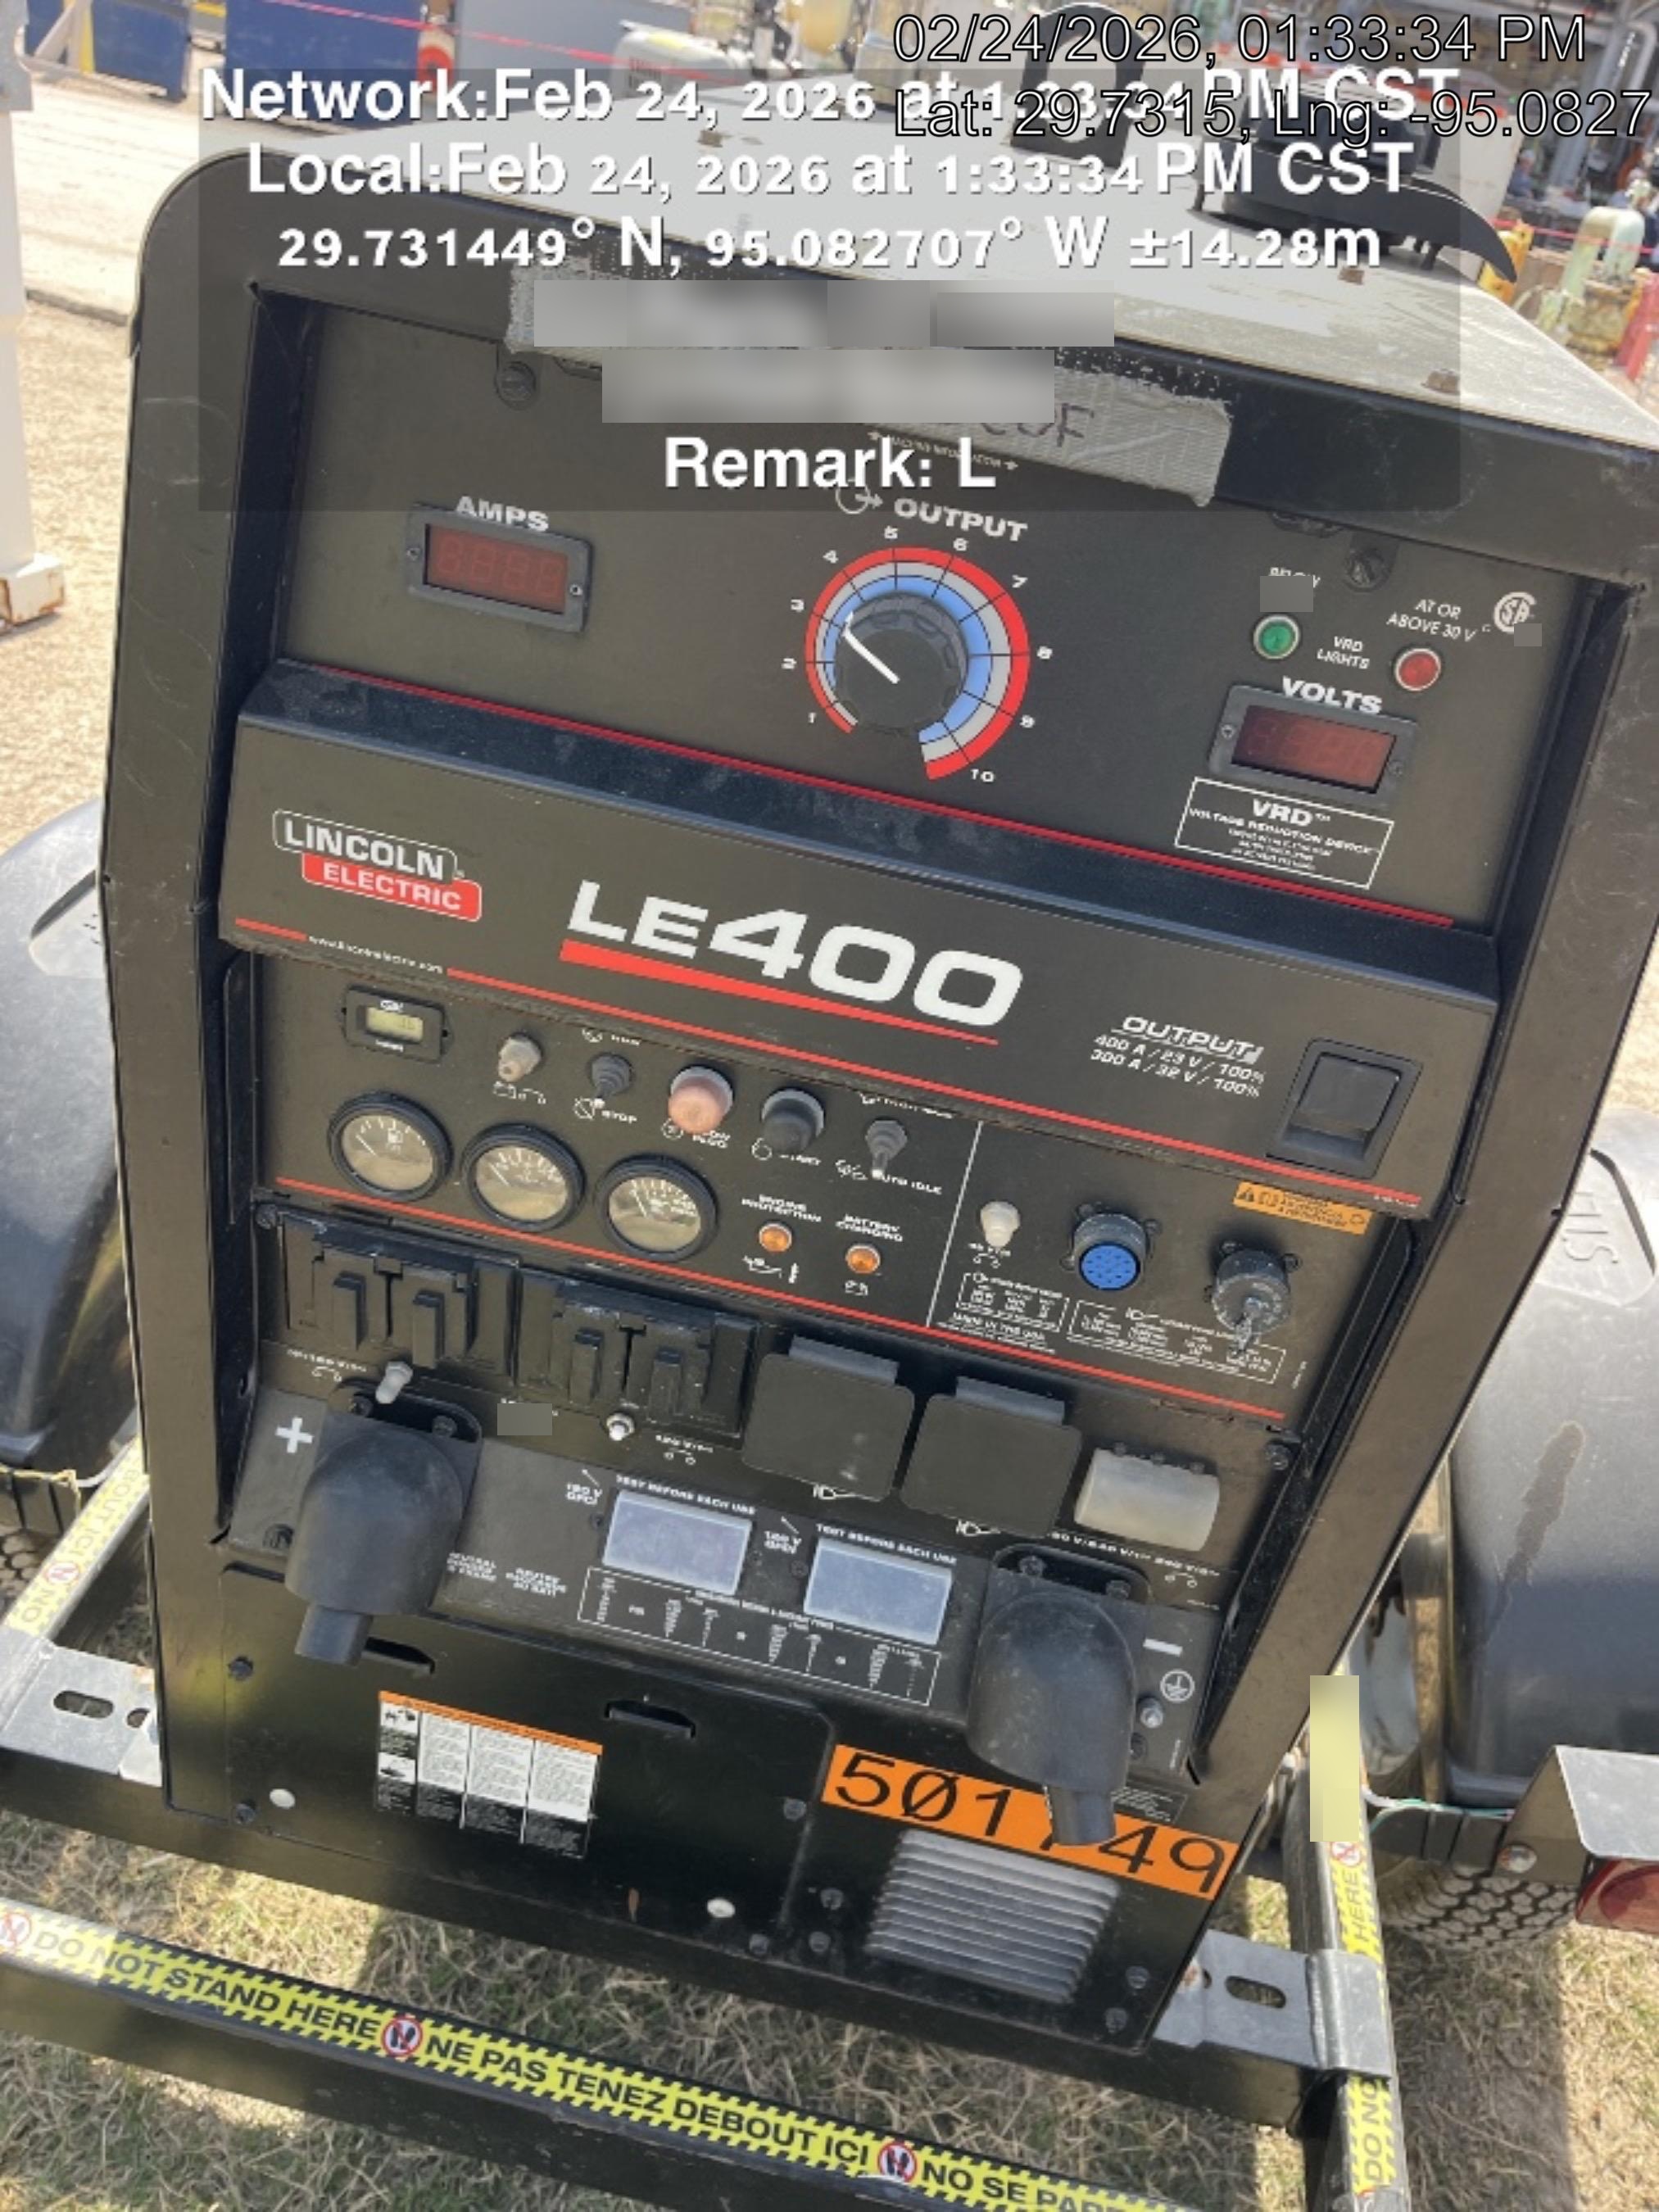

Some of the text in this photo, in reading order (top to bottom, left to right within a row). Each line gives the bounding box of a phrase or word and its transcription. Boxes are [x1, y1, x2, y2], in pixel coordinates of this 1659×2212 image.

[456, 496, 549, 532] AMPS
[894, 497, 1027, 542] OUTPUT
[884, 526, 898, 539] 5
[954, 538, 968, 551] 6
[823, 550, 838, 564] 4
[1012, 574, 1027, 588] 7
[791, 599, 805, 612] 3
[1415, 599, 1461, 620] AT OR
[1386, 613, 1477, 642] ABOVE 30 V
[1037, 646, 1053, 660] 8
[1317, 649, 1370, 670] LIGHTS
[1333, 637, 1363, 652] VRD
[782, 658, 796, 670] 2
[1282, 675, 1382, 714] VOLTS
[809, 712, 816, 723] 1
[1021, 715, 1036, 728] 9
[971, 768, 994, 782] 10
[284, 818, 443, 881] LINCOLN
[323, 862, 461, 911] ELECTRIC
[567, 879, 1022, 1027] LE400
[1122, 1016, 1253, 1056] OUTPUT
[1090, 1049, 1125, 1066] 300
[1128, 1057, 1141, 1071] A
[1184, 1071, 1197, 1084] V
[1213, 1077, 1262, 1098] 100%
[1094, 1035, 1129, 1052] 400
[1134, 1043, 1145, 1055] A
[1189, 1055, 1203, 1068] V
[1217, 1063, 1267, 1086] 100%
[835, 1752, 1226, 1894] 50149
[1344, 1871, 1367, 1942] HERE
[33, 1931, 379, 2042] DO NOT STAND HERE
[425, 2034, 869, 2167] NE PAS TENEZ DEBOUT ICI
[922, 2160, 973, 2192] NO
[982, 2178, 1028, 2203] SE
